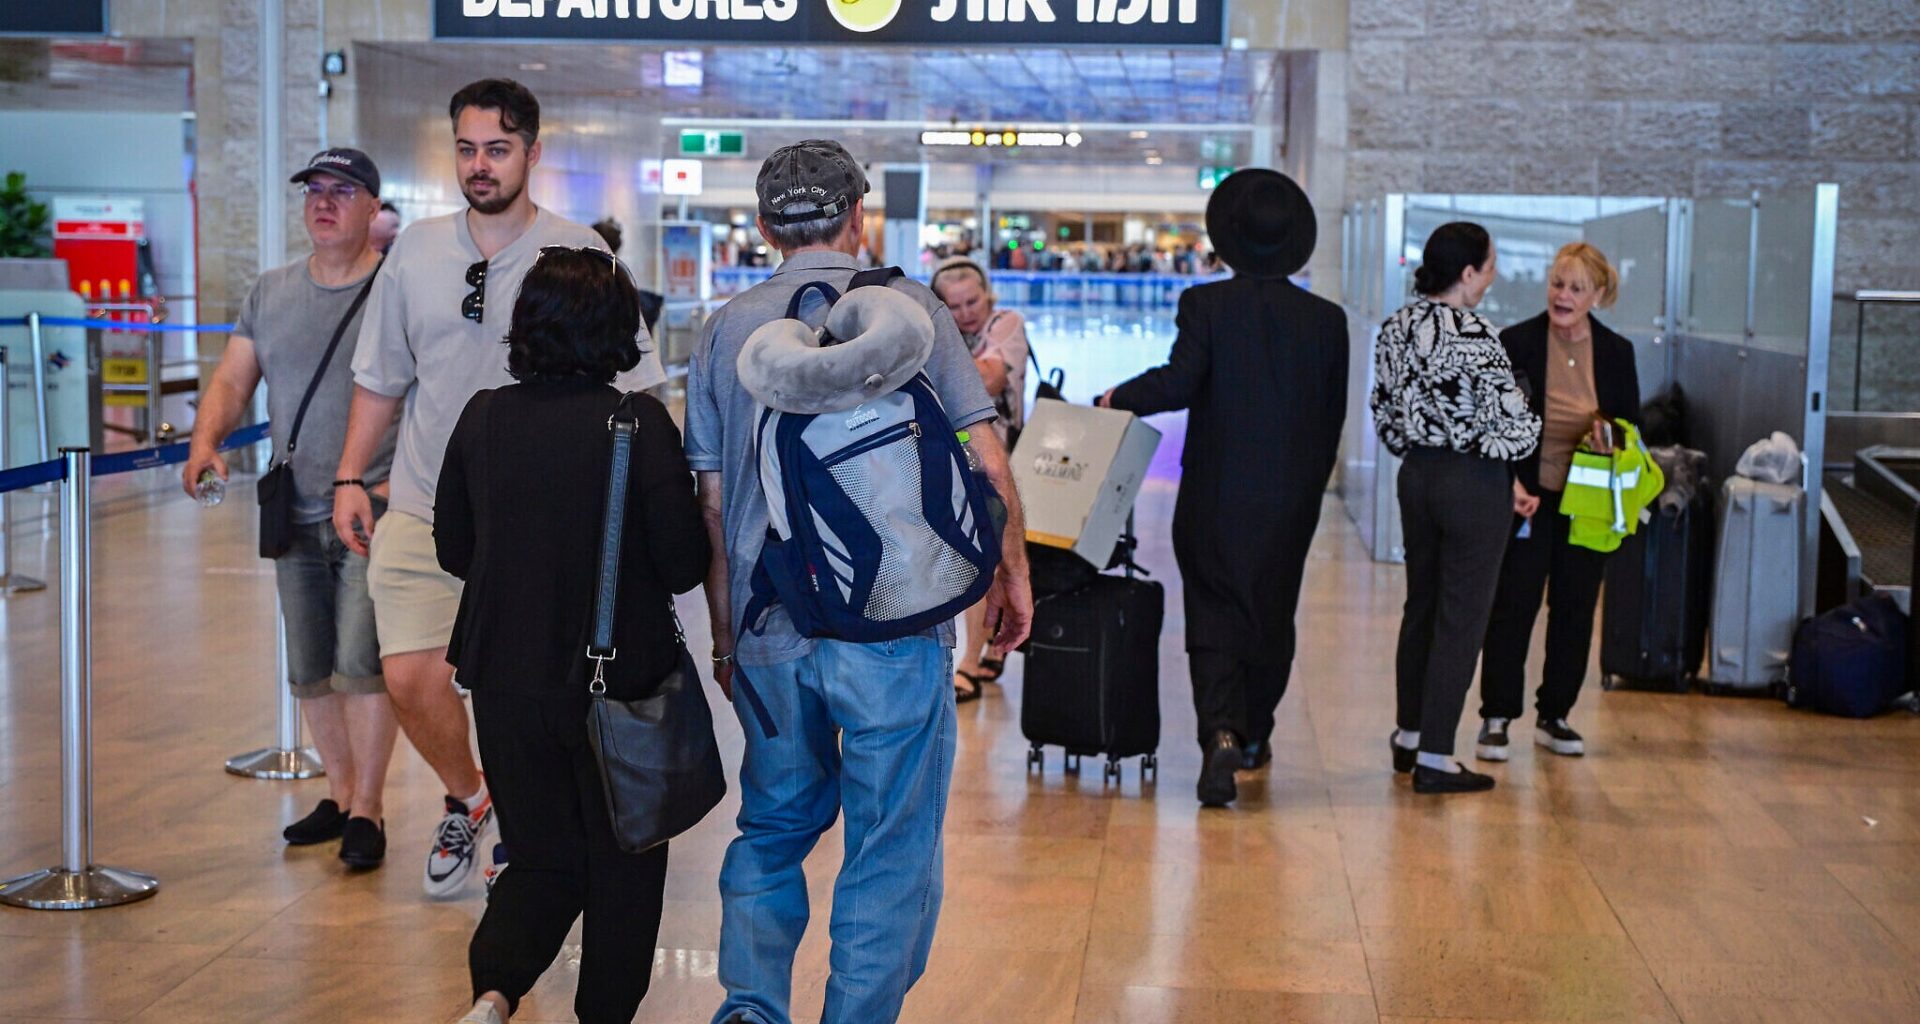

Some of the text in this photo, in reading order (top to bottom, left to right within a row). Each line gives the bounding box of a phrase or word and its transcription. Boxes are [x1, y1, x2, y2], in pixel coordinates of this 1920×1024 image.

[771, 185, 828, 206] New York City
